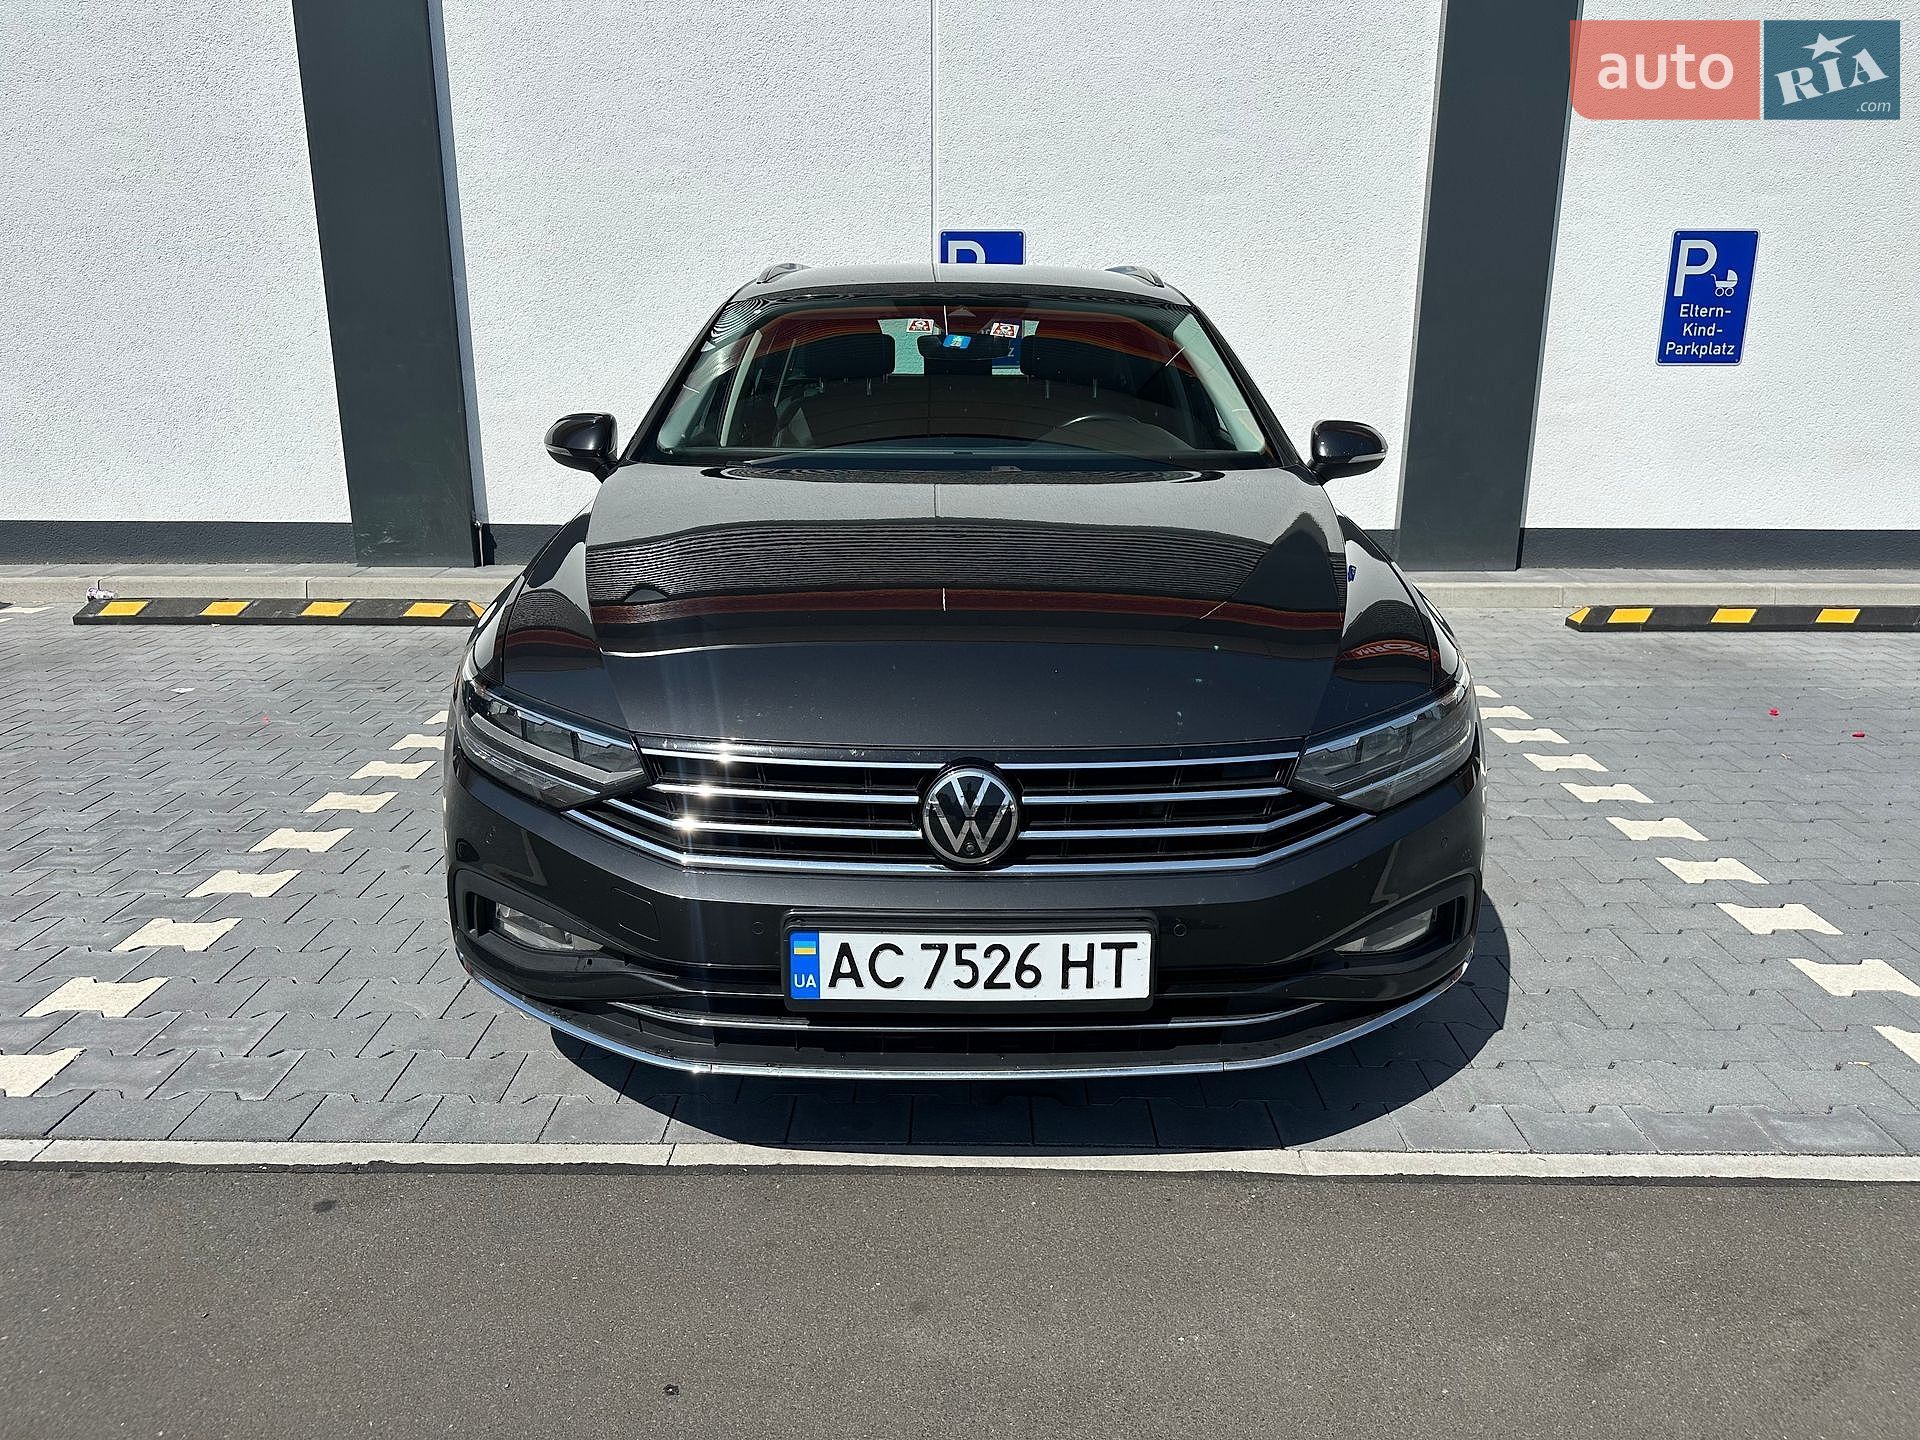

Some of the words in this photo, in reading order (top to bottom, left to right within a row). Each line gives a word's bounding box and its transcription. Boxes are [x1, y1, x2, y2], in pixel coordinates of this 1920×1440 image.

[1673, 239, 1718, 297] P
[1679, 303, 1732, 319] Eltern-
[1682, 322, 1724, 337] Kind-
[1665, 342, 1736, 359] Parkplatz
[924, 774, 1016, 855] VW
[828, 942, 905, 990] AC
[920, 942, 1043, 990] 7526
[1060, 942, 1139, 990] HT
[793, 973, 818, 989] UA
